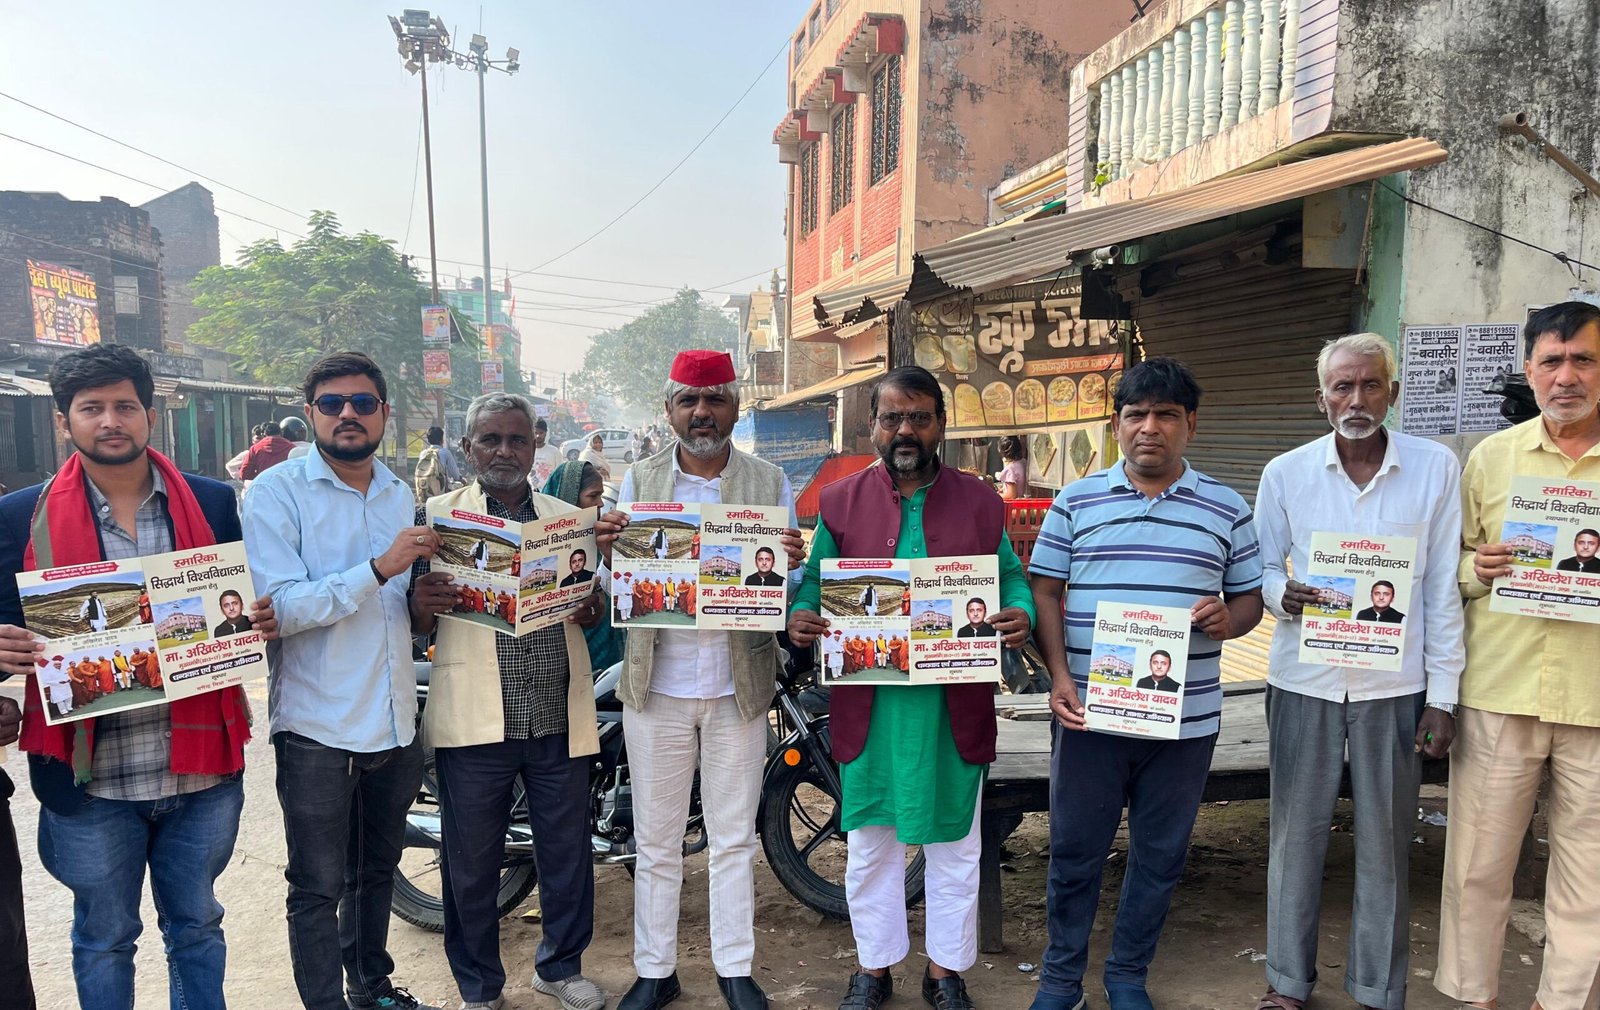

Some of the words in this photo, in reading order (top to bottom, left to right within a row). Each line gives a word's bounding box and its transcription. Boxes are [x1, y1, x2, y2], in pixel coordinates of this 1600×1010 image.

[1420, 330, 1458, 338] 8881519552
[1479, 326, 1516, 334] 8881519552
[1419, 344, 1458, 359] बवासीर
[1407, 370, 1424, 380] गुप्त
[1424, 369, 1437, 377] रोग
[1465, 366, 1481, 376] गुप्त
[1481, 365, 1494, 373] रोग
[1511, 496, 1549, 512] सिद्धार्थ
[704, 521, 733, 534] सिद्धार्थ
[734, 522, 784, 536] विश्वविद्यालय
[1568, 516, 1580, 526] हेतु
[524, 537, 549, 552] सिद्धार्थ
[551, 527, 594, 545] विश्वविद्यालय
[1313, 550, 1347, 565] सिद्धार्थ
[1348, 553, 1410, 570] विश्वविद्यालय
[150, 571, 185, 591] सिद्धार्थ
[187, 563, 246, 586] विश्वविद्यालय
[914, 576, 941, 589] सिद्धार्थ
[943, 574, 995, 588] विश्वविद्यालय
[1522, 569, 1572, 585] अखिलेश
[521, 598, 534, 608] मा.
[536, 590, 569, 604] अखिलेश
[571, 583, 592, 595] यादव
[702, 588, 716, 598] मा.
[719, 586, 758, 599] अखिलेश
[759, 588, 783, 599] यादव
[1499, 589, 1528, 599] धन्यवाद
[1529, 592, 1542, 600] एवं
[1542, 594, 1567, 602] आभार
[1567, 596, 1599, 606] अभियान
[1098, 619, 1128, 633] सिद्धार्थ
[1129, 622, 1185, 640] विश्वविद्यालय
[1305, 621, 1322, 630] मा.
[1325, 619, 1371, 635] अखिलेश
[1373, 626, 1402, 637] यादव
[165, 651, 183, 663] मा.
[186, 639, 231, 659] अखिलेश
[233, 633, 260, 650] यादव
[914, 643, 929, 652] मा.
[931, 639, 970, 651] अखिलेश
[973, 640, 997, 650] यादव
[1307, 640, 1334, 649] धन्यवाद
[1334, 642, 1345, 650] एवं
[1344, 644, 1367, 652] आभार
[1367, 645, 1396, 654] अभियान
[172, 668, 200, 681] धन्यवाद
[200, 665, 211, 675] एवं
[212, 660, 234, 673] आभार
[234, 654, 260, 667] अभियान
[940, 660, 950, 668] एवं
[970, 659, 995, 667] अभियान
[1089, 685, 1105, 696] मा.
[1107, 687, 1149, 702] अखिलेश
[1151, 694, 1178, 705] यादव
